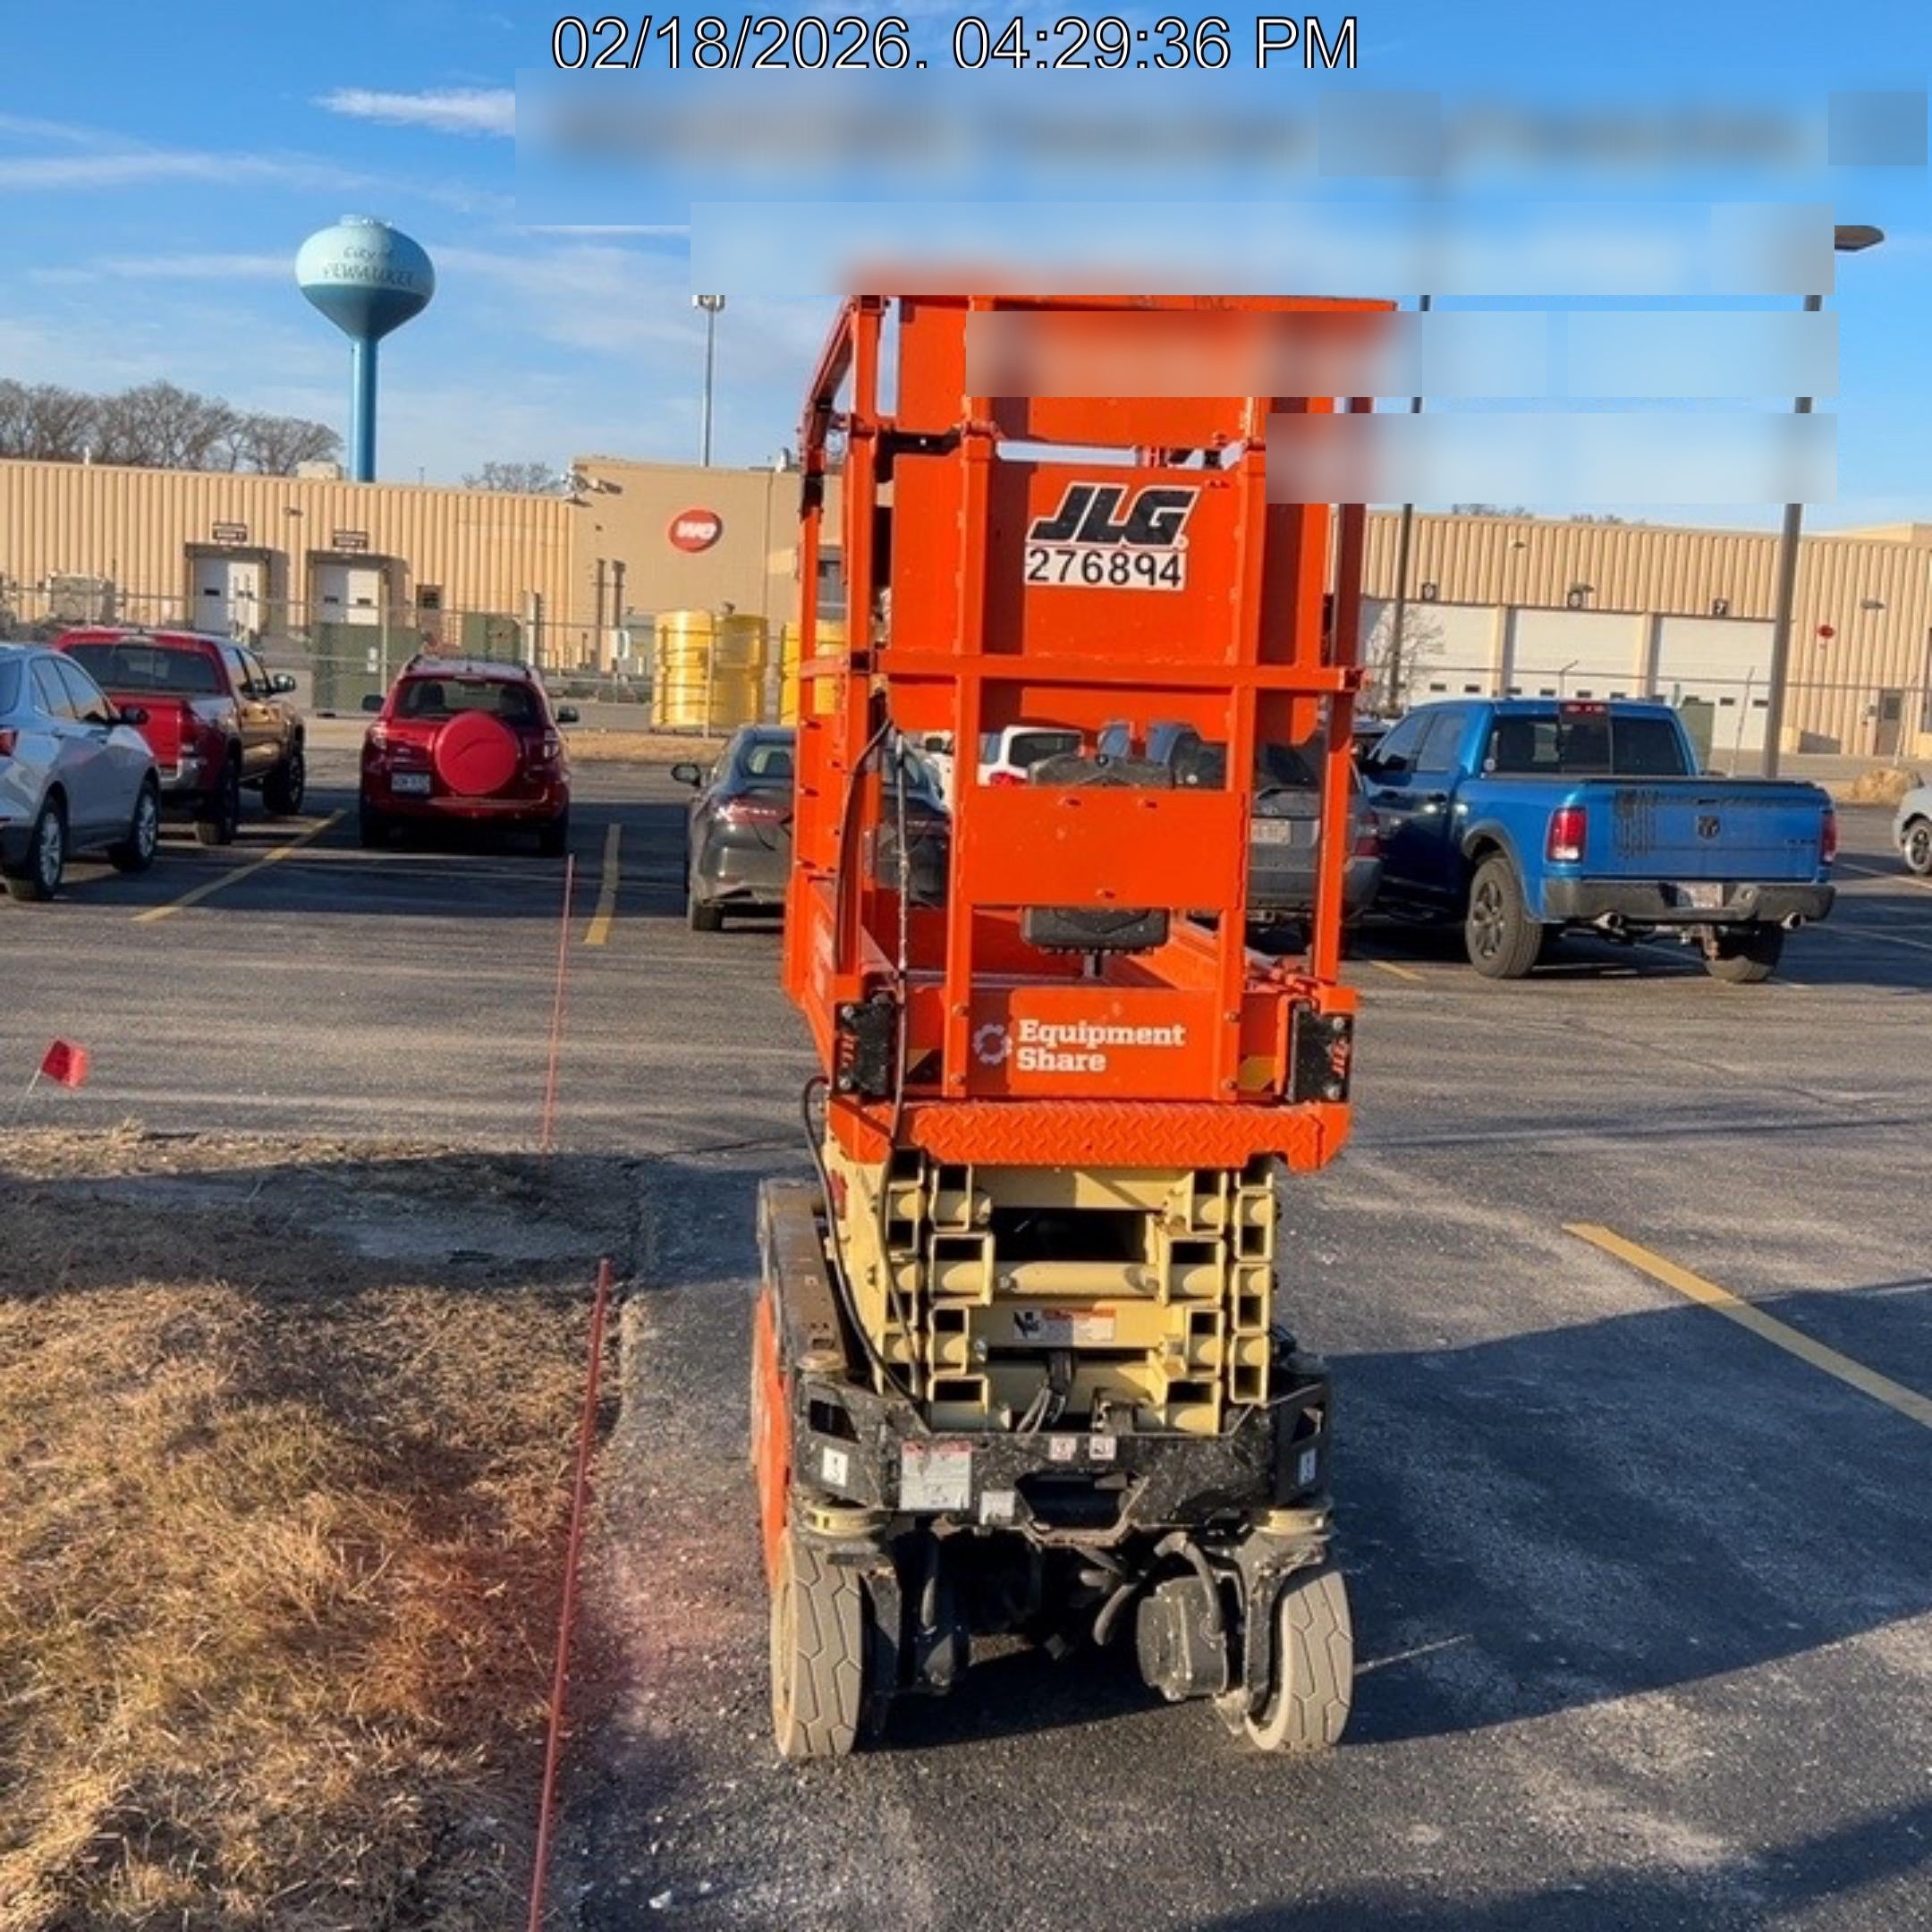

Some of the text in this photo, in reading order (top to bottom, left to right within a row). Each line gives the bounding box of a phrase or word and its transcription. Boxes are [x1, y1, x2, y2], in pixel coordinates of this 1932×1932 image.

[1028, 483, 1198, 547] JLG
[1028, 548, 1182, 587] 276894
[1018, 1019, 1186, 1049] Equipment
[1016, 1046, 1107, 1072] Share
